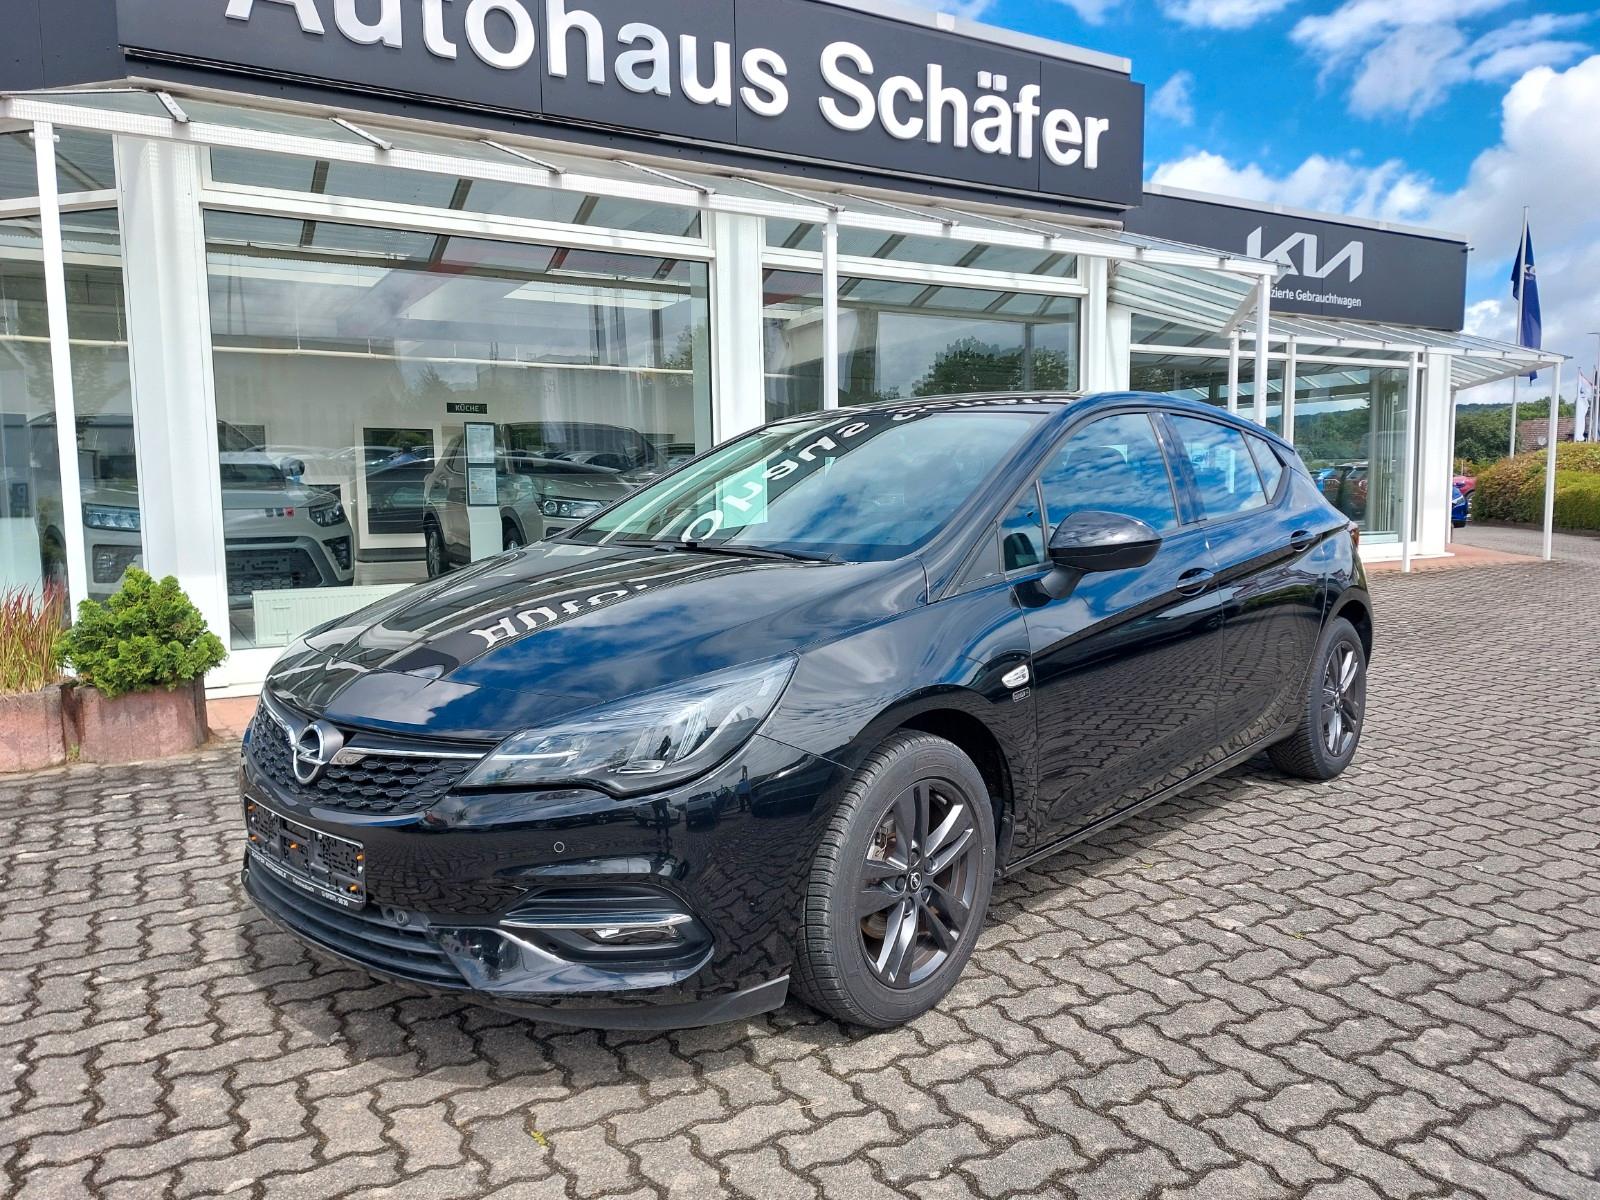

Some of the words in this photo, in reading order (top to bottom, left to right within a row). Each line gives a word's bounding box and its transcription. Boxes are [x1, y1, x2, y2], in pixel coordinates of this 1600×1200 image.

[818, 41, 1109, 170] Schäfer
[1271, 287, 1294, 300] zierte
[1295, 289, 1362, 309] Gebrauchtwagen
[455, 403, 480, 412] KÜCHE
